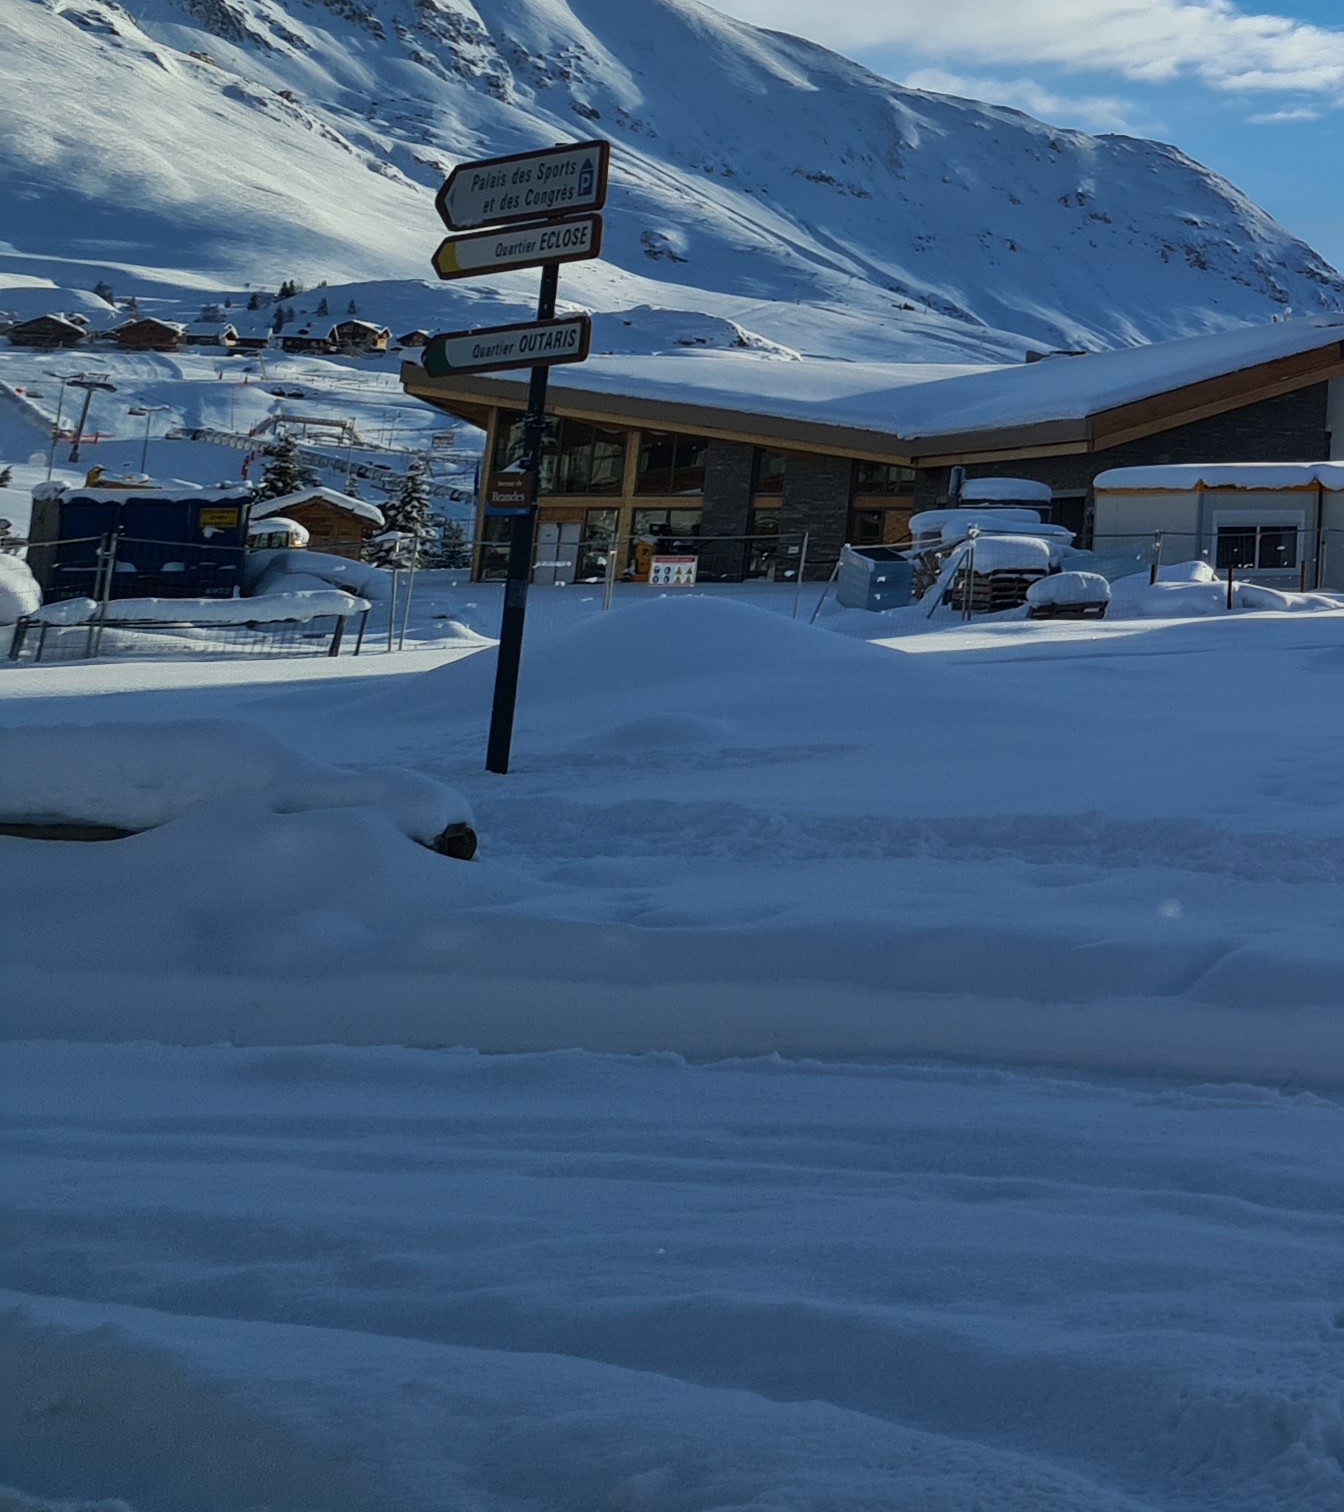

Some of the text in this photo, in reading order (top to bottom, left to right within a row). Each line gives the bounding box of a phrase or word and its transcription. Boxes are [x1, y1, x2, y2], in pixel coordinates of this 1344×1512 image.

[471, 161, 577, 192] Palais des Sports
[482, 184, 575, 214] et des Congrès
[495, 226, 589, 258] Quartier ECLOSE
[472, 328, 578, 359] Quartier OUTARIS
